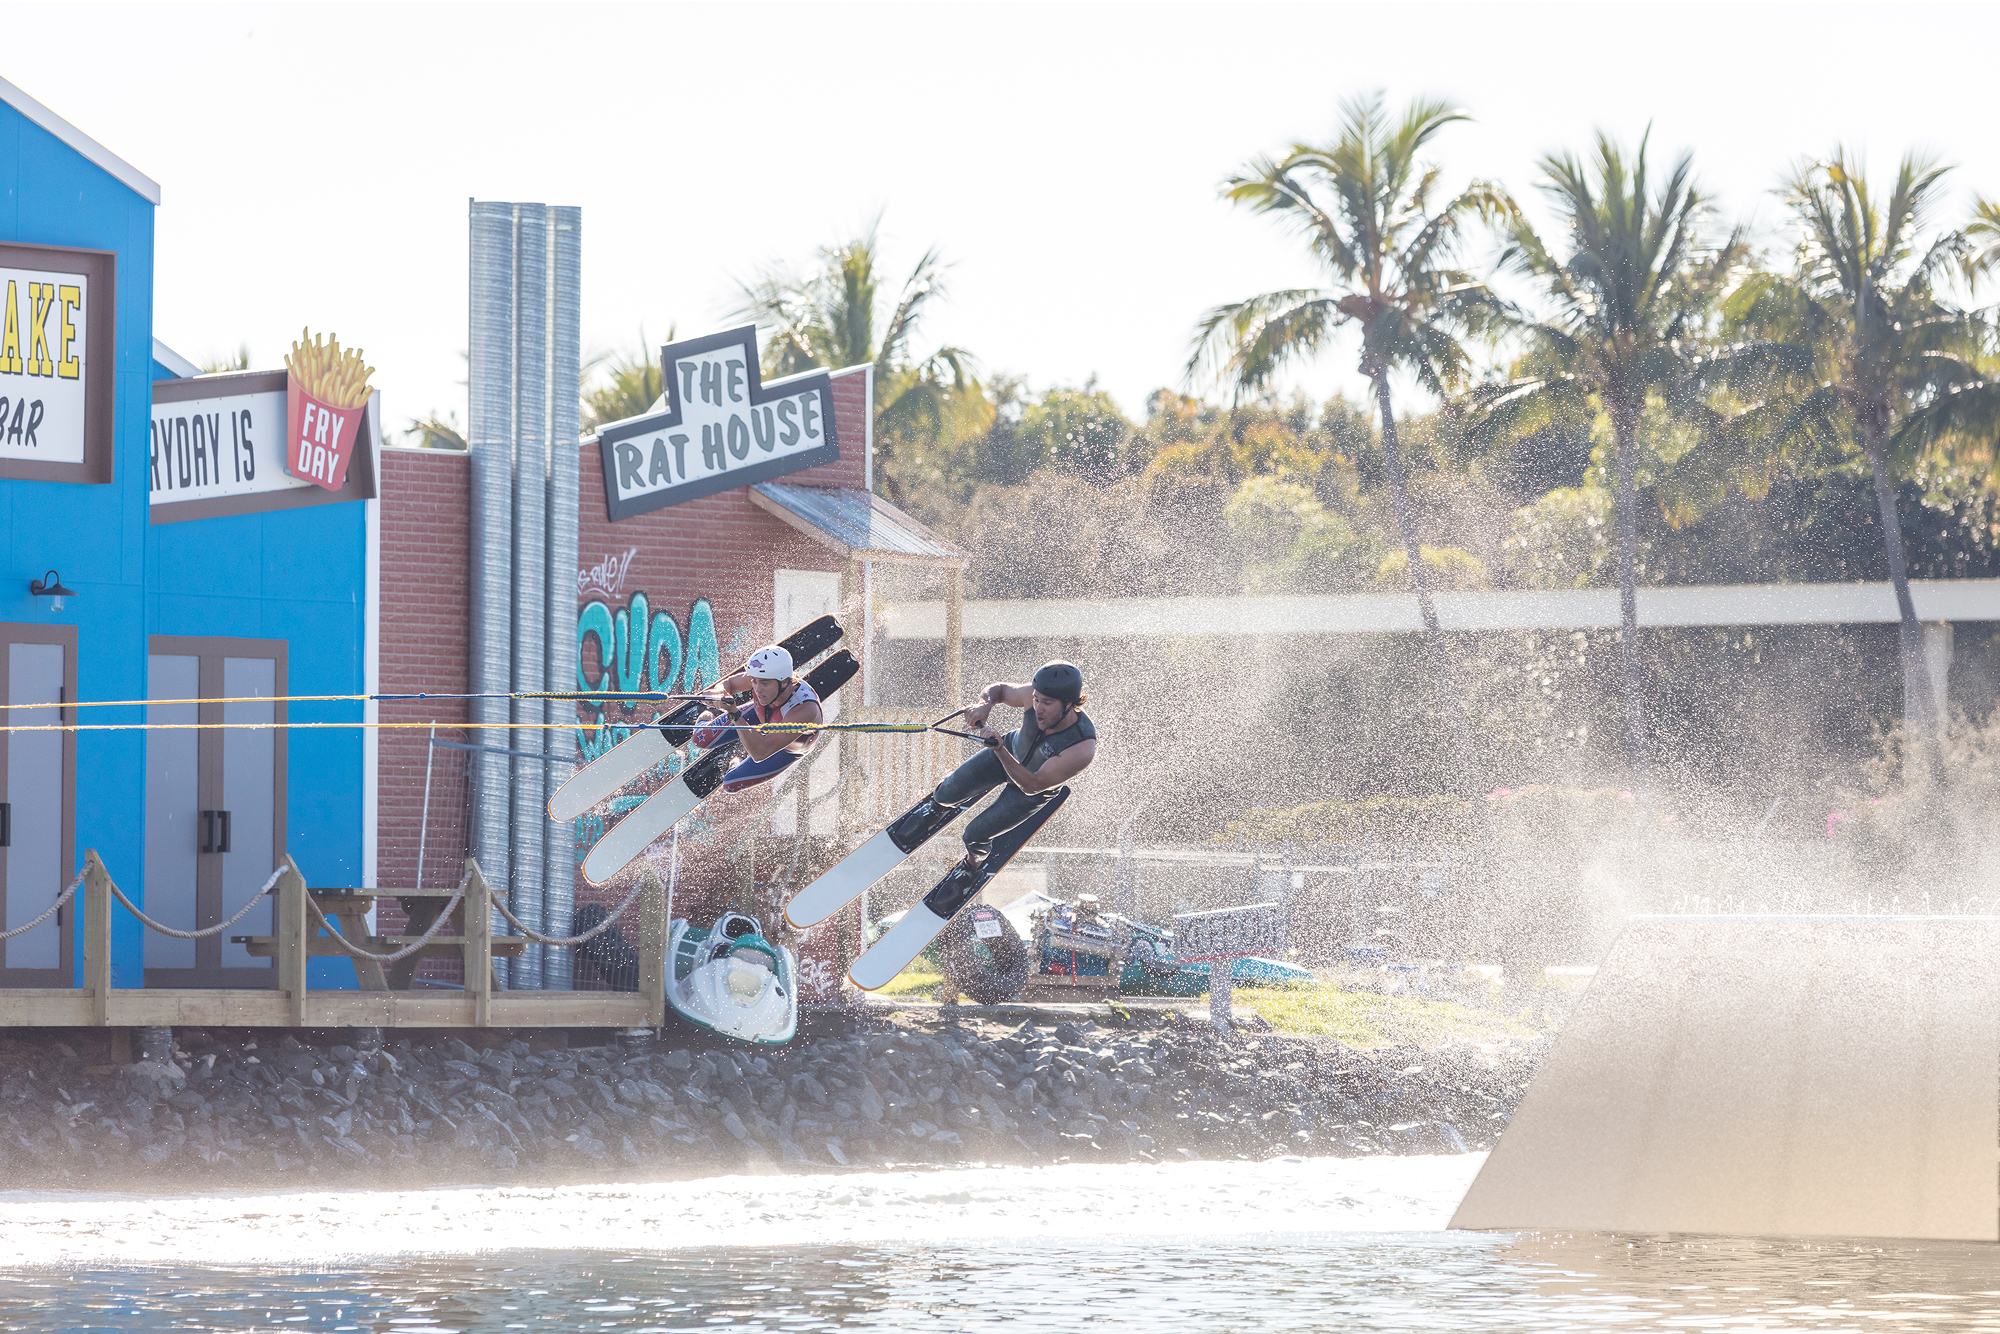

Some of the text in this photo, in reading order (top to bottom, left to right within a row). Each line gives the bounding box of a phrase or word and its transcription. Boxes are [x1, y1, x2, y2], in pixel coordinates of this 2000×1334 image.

[0, 279, 81, 380] AKE
[677, 359, 745, 407] THE
[302, 402, 345, 450] FRY
[614, 391, 820, 490] RAT HOUSE
[150, 409, 256, 492] RYDAY IS
[297, 440, 340, 485] DAY
[1180, 914, 1237, 956] KEEP
